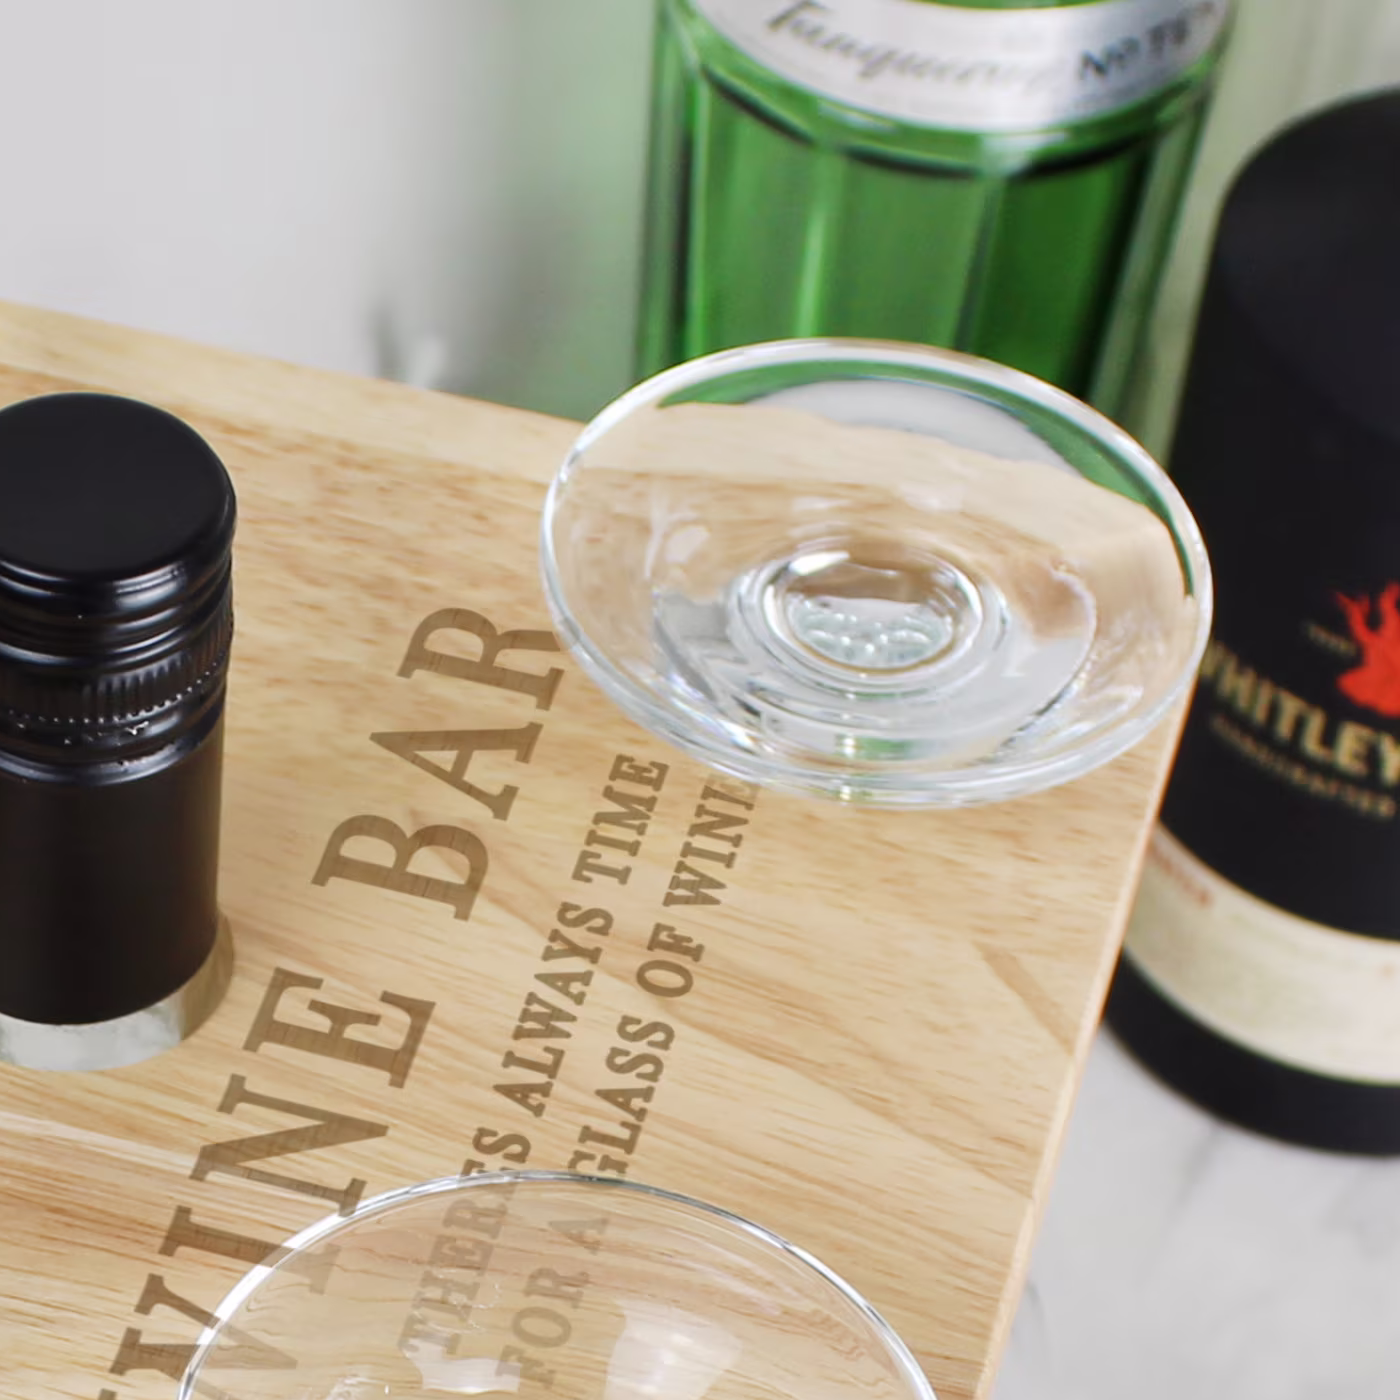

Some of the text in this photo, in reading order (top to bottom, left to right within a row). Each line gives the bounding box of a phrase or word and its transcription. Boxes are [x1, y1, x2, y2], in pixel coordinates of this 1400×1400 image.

[310, 607, 565, 923] BAR
[492, 901, 614, 1118] ALWAYS
[571, 754, 670, 886] TIME
[495, 773, 760, 1390] FOR A GLASS OF WINE
